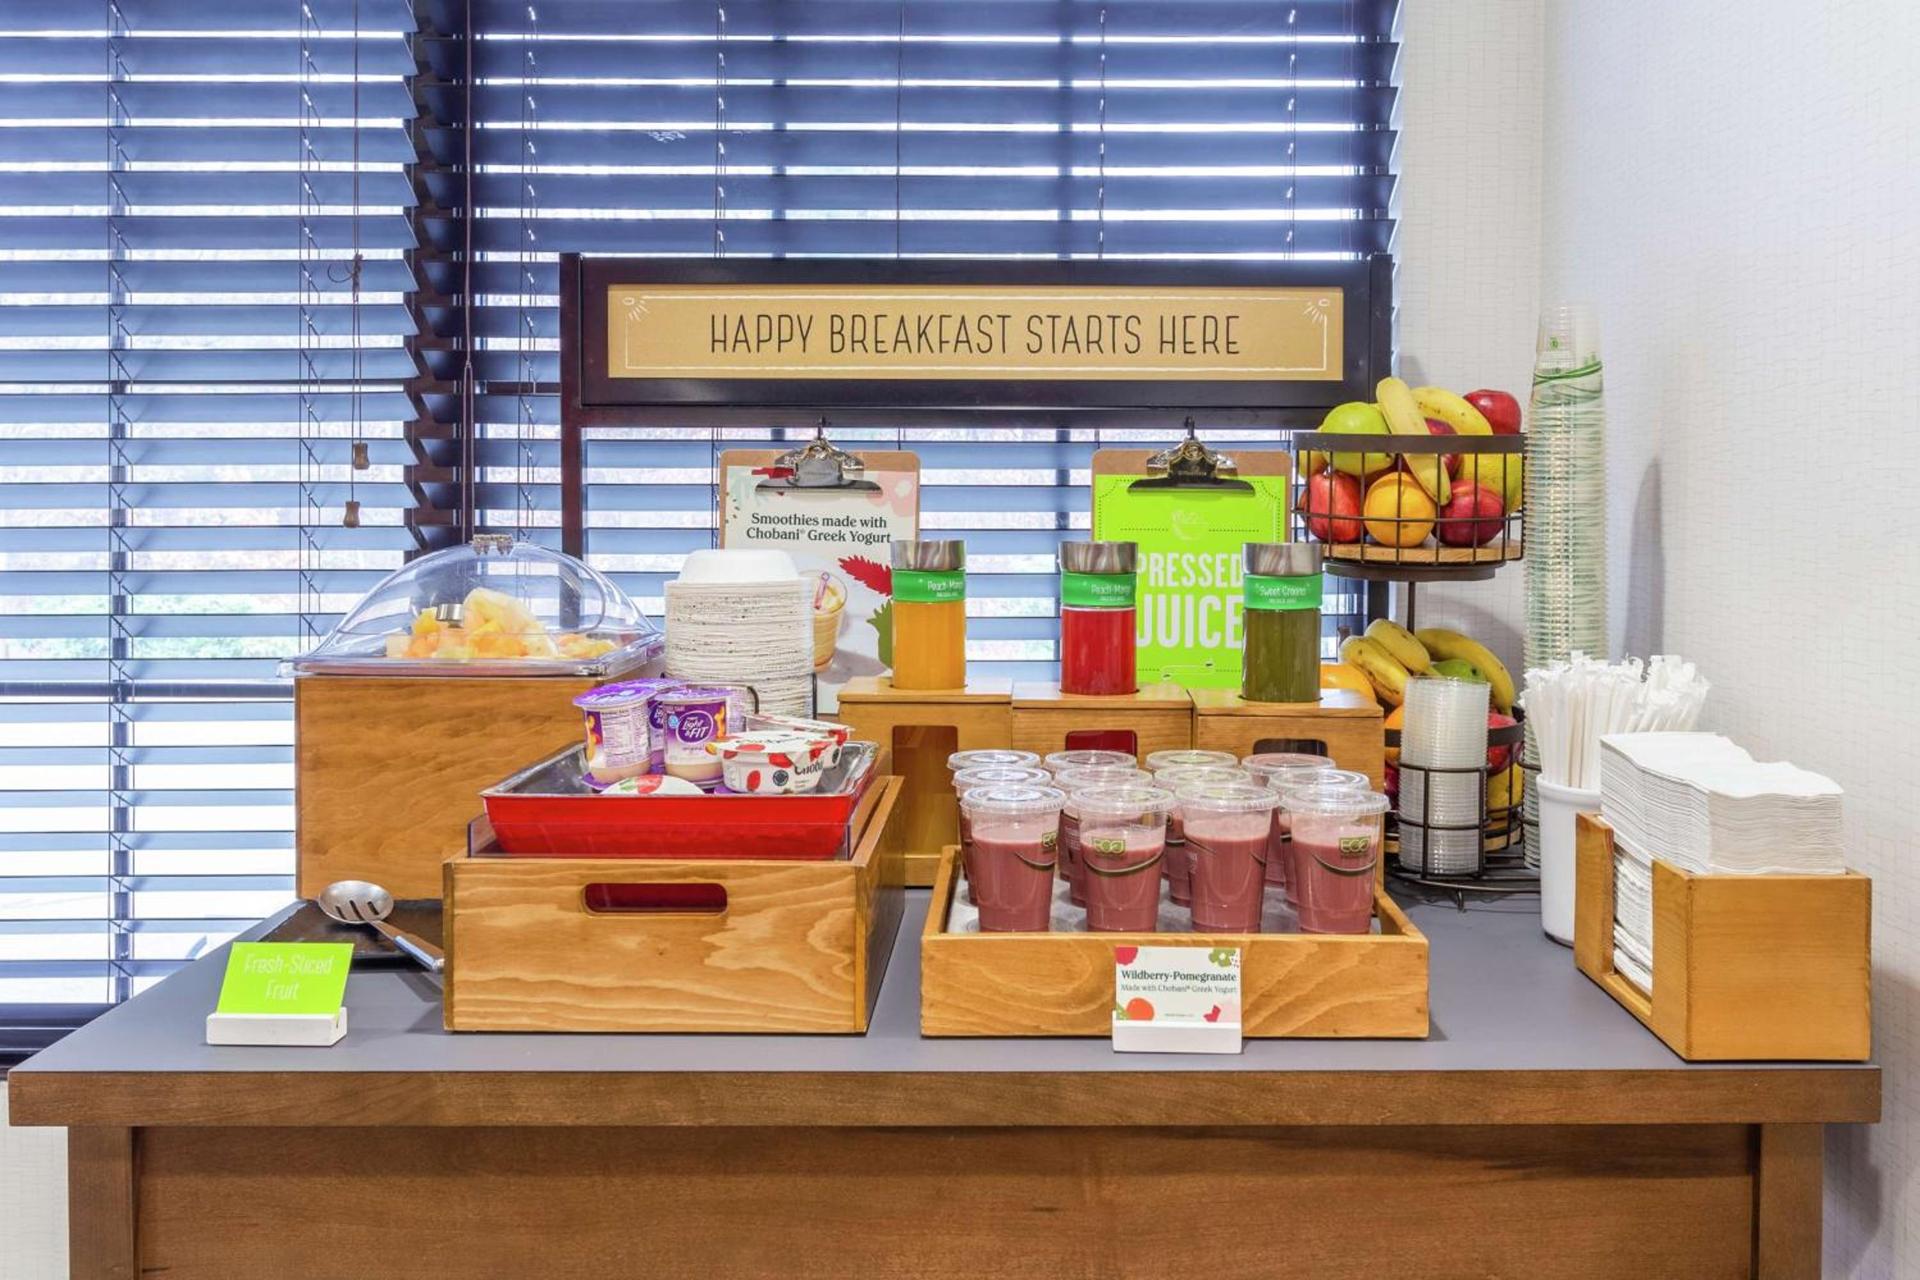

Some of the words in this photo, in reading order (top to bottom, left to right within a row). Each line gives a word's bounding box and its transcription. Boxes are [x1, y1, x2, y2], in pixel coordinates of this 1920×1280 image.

[711, 314, 813, 353] HAPPY
[830, 314, 1012, 353] BREAKFAST
[1026, 315, 1142, 354] STARTS
[1160, 315, 1240, 354] HERE
[751, 512, 819, 526] Smoothies
[822, 515, 858, 528] made
[860, 516, 887, 529] with
[808, 529, 846, 543] Greek
[850, 530, 891, 545] Yogurt
[1136, 593, 1242, 649] JUICE
[265, 978, 300, 1001] Fruit
[1121, 984, 1140, 992] Made
[1142, 984, 1156, 992] with
[1192, 985, 1212, 993] Greek
[1215, 985, 1237, 994] Yogurt
